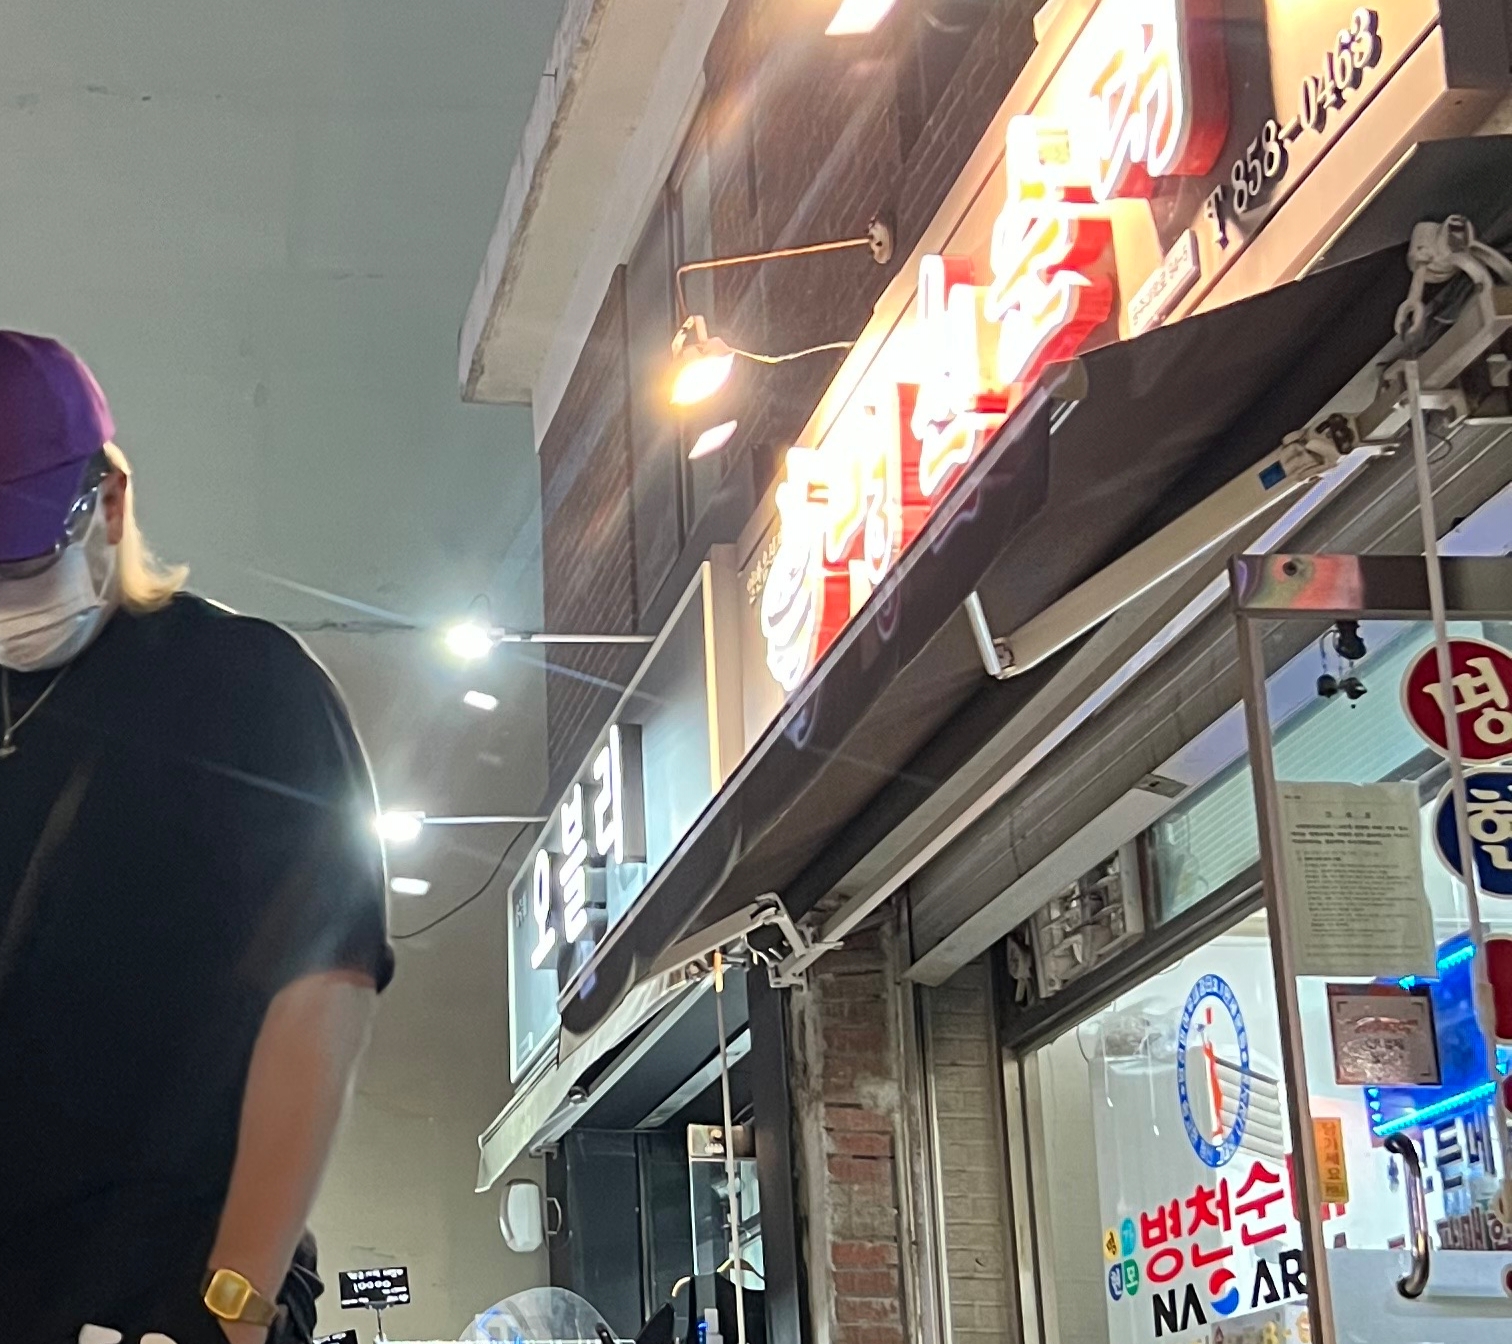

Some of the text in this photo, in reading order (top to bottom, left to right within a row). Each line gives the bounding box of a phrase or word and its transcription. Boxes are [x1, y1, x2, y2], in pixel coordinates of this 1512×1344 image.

[1231, 7, 1382, 216] 858-0463
[531, 723, 624, 970] 오블리
[1139, 1154, 1301, 1284] 병천순
